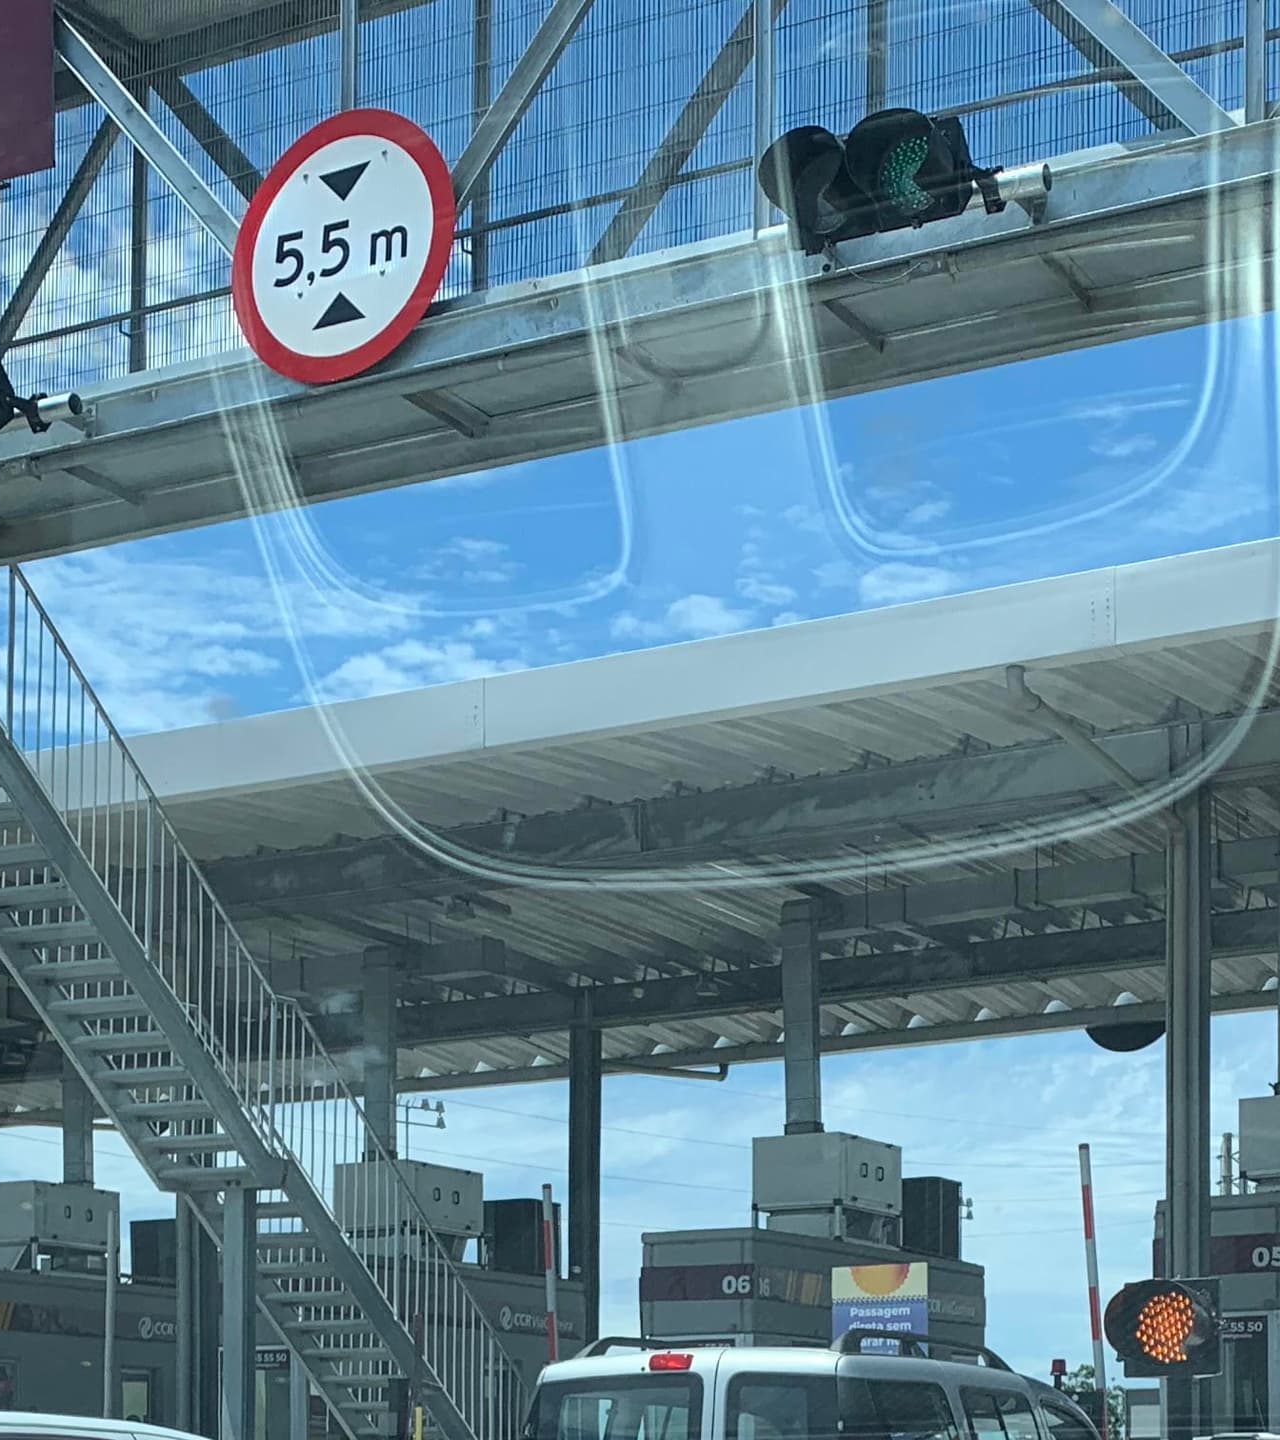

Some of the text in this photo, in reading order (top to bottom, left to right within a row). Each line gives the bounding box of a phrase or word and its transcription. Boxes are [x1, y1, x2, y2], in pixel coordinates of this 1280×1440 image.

[273, 219, 408, 288] 5,5 m
[721, 1275, 751, 1295] 06
[849, 1307, 911, 1318] Passagem
